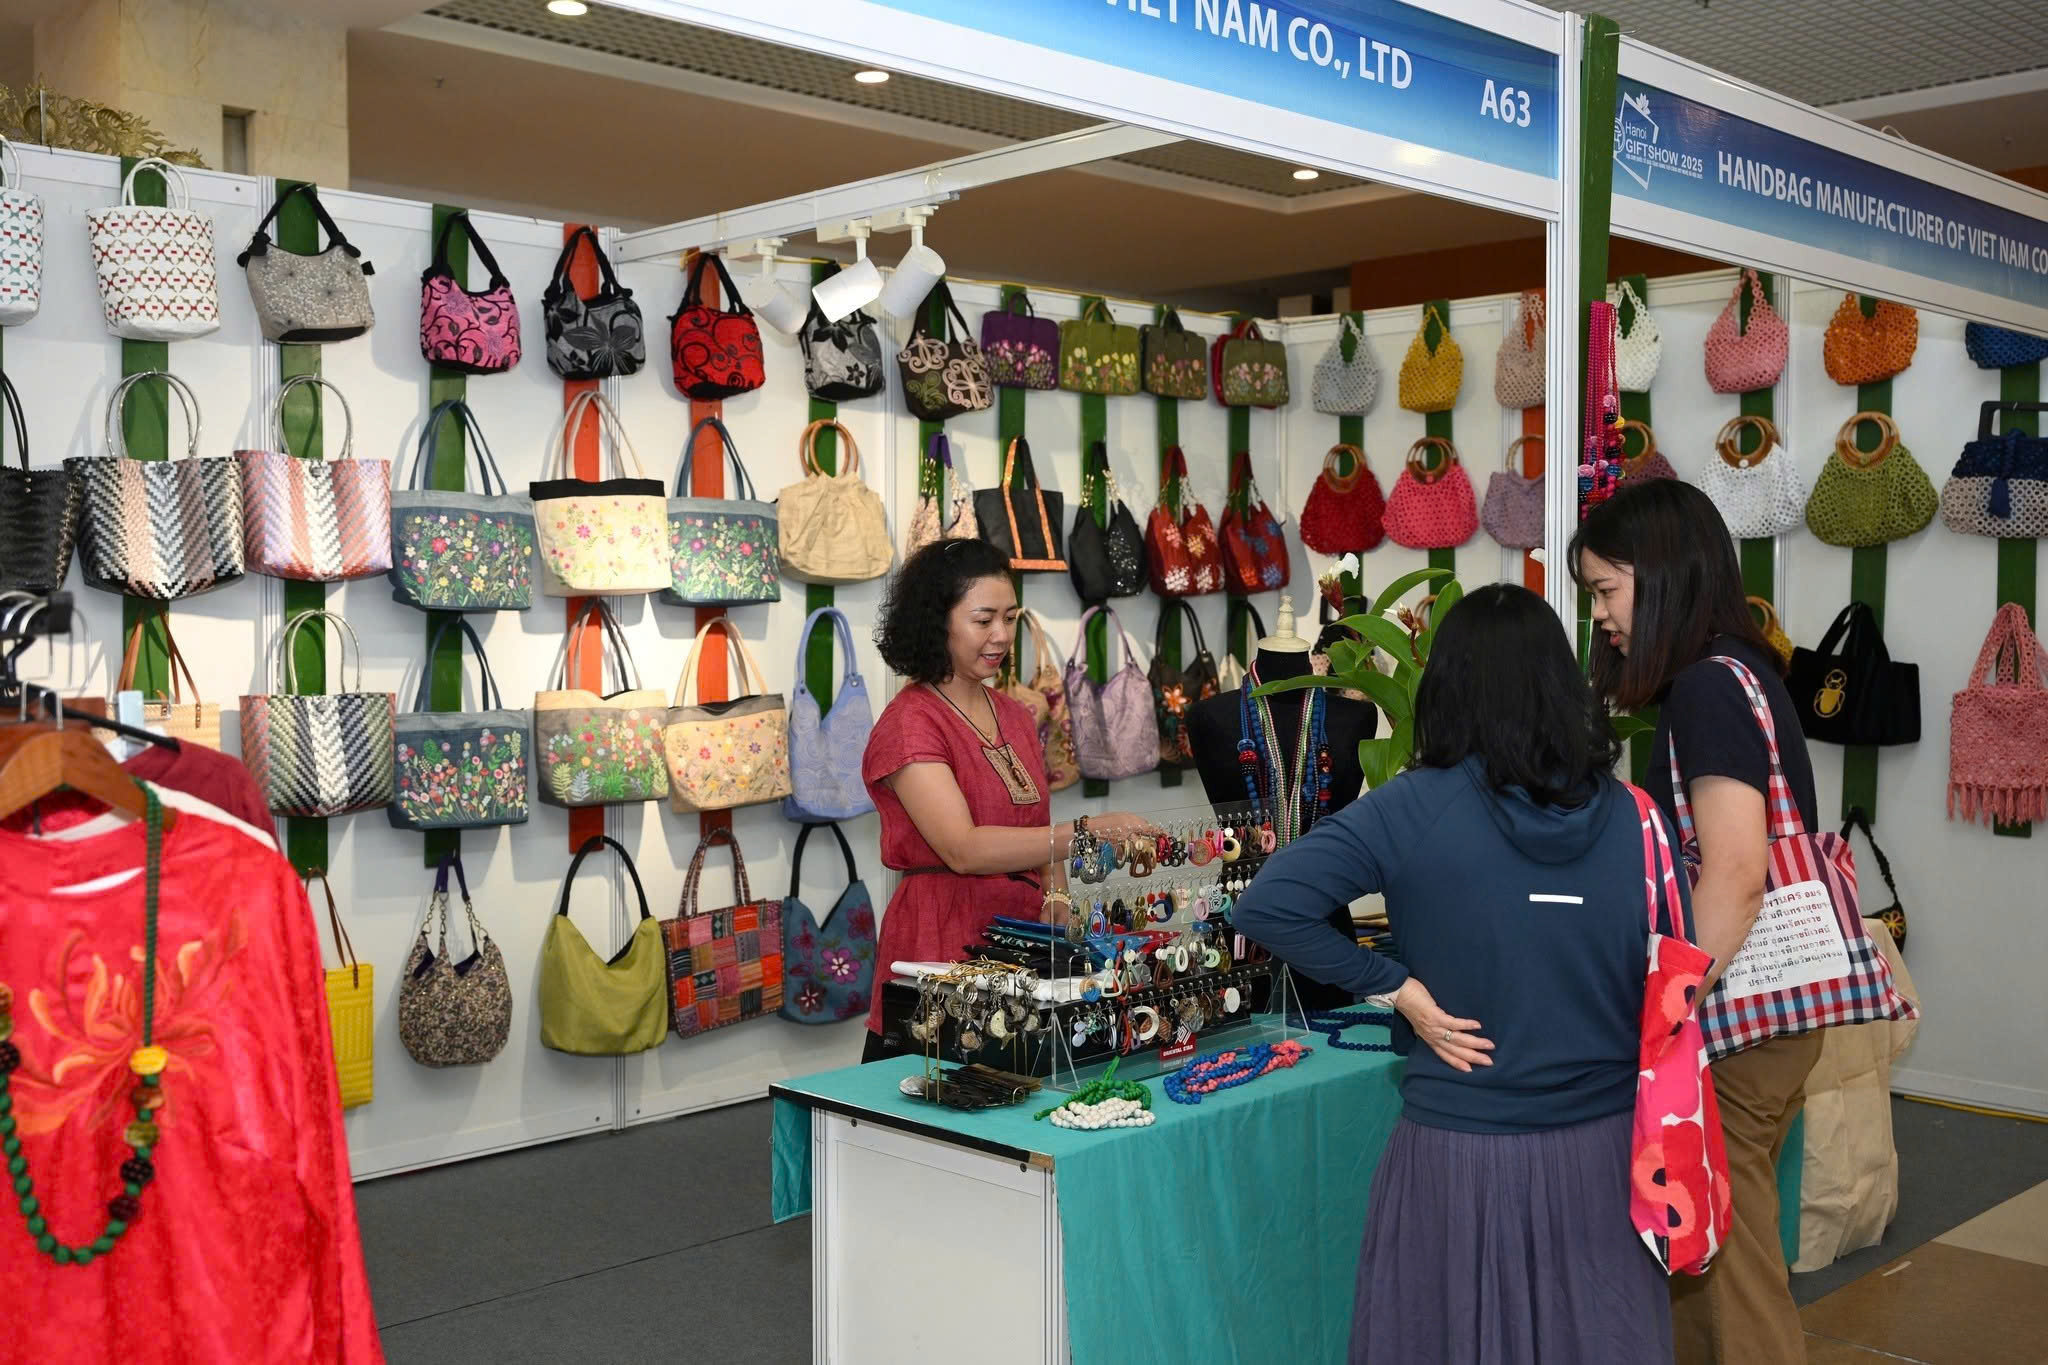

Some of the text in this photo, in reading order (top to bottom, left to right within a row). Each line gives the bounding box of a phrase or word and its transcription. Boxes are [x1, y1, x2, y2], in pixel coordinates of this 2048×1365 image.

[1195, 0, 1278, 53] NAM
[1287, 18, 1349, 79] CO.,
[1359, 36, 1413, 90] LTD
[1480, 79, 1531, 128] A63
[1625, 121, 1647, 140] Hanoi
[1625, 139, 1679, 167] GIFTSHOW
[1681, 154, 1703, 173] 2025
[1717, 150, 1812, 209] HANDBAG
[1816, 179, 1944, 246] MANUFACTURER
[1946, 220, 1965, 251] OF
[1968, 225, 1997, 261] VIET
[1999, 235, 2029, 271] NAM
